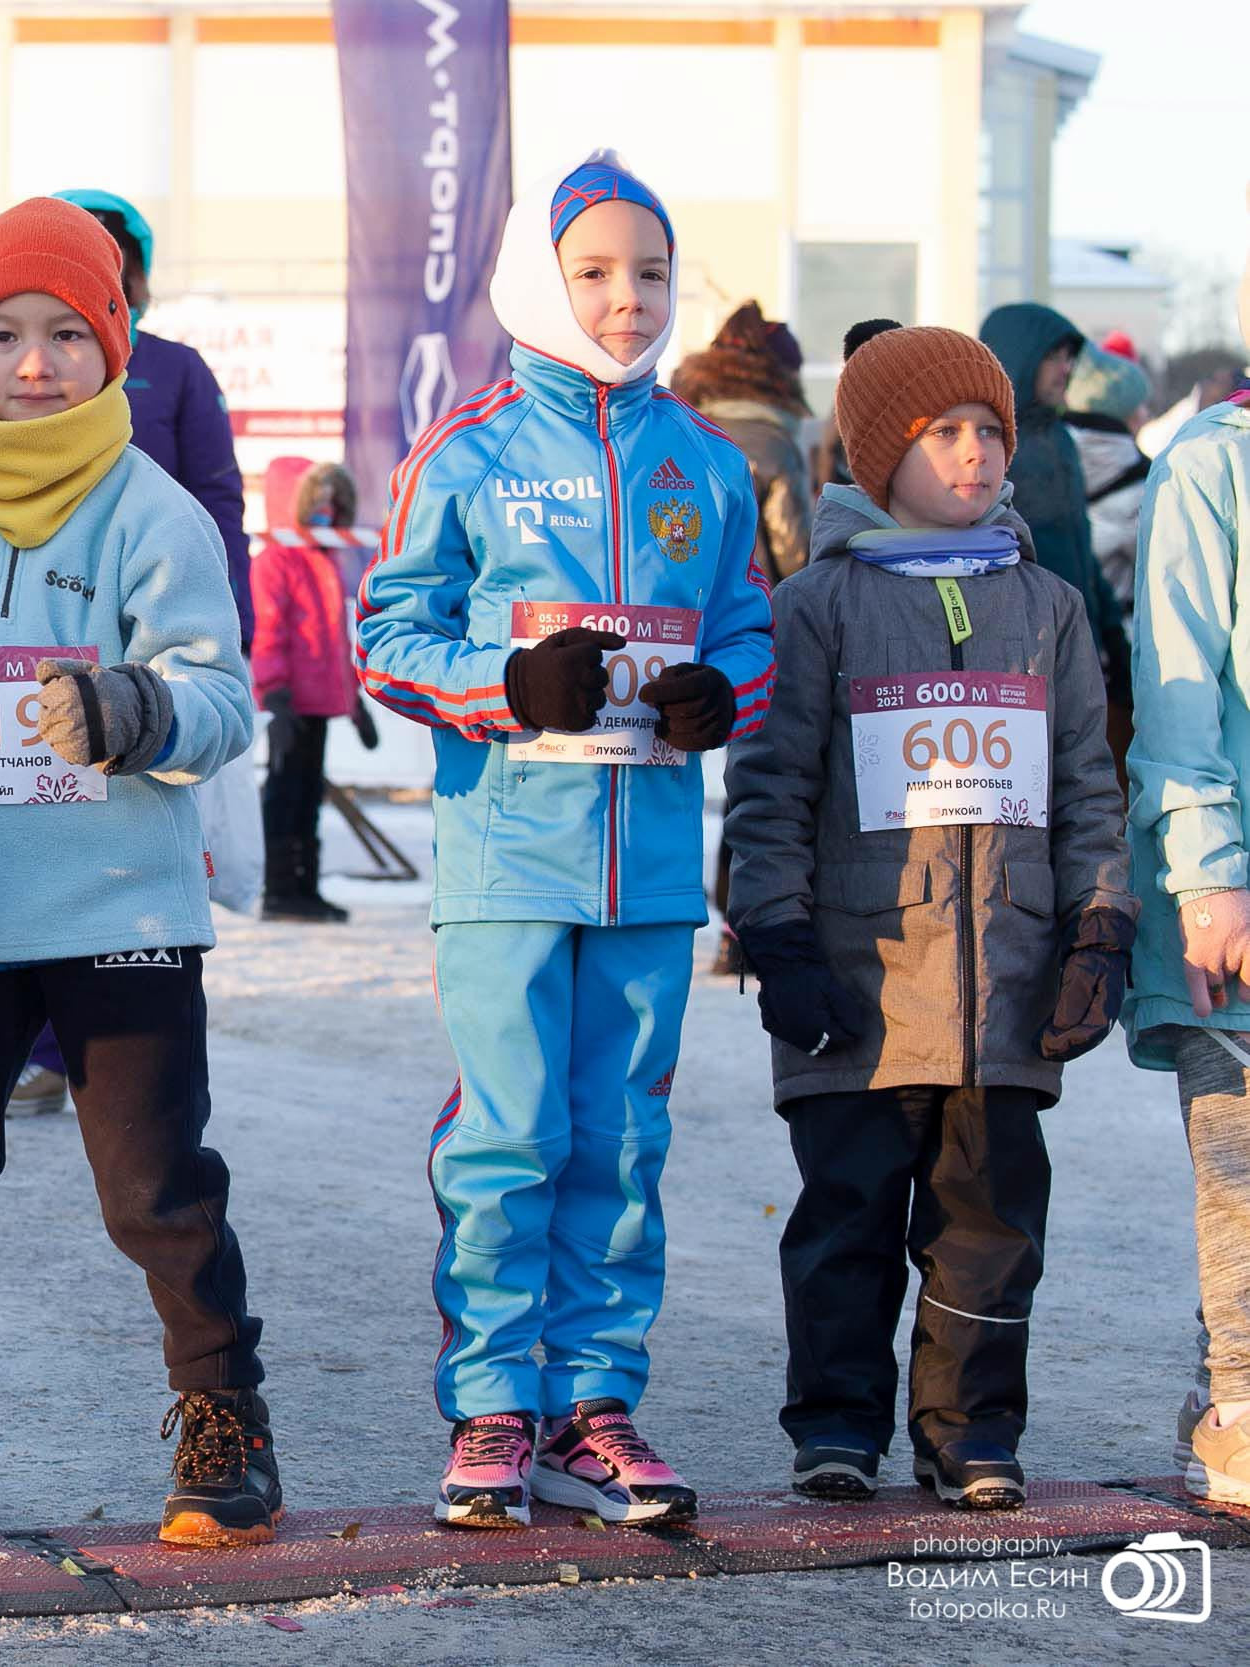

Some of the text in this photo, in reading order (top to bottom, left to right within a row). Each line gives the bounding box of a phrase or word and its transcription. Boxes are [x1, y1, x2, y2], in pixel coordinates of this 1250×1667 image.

[496, 476, 602, 501] LUKOIL
[649, 477, 695, 490] adidas
[550, 514, 592, 529] RUSAL
[539, 614, 568, 623] 05.12
[580, 615, 652, 637] 600 М
[6, 661, 24, 677] М
[876, 685, 904, 696] 05.12
[916, 682, 988, 703] 600 М
[877, 696, 904, 707] 2021
[604, 716, 659, 730] ДЕМИДЕ
[596, 745, 637, 756] ЛУКОЙЛ
[902, 718, 1012, 771] 606
[906, 778, 1013, 792] МИРОН ВОРОБЬЕВ
[941, 806, 982, 817] ЛУКОЙЛ
